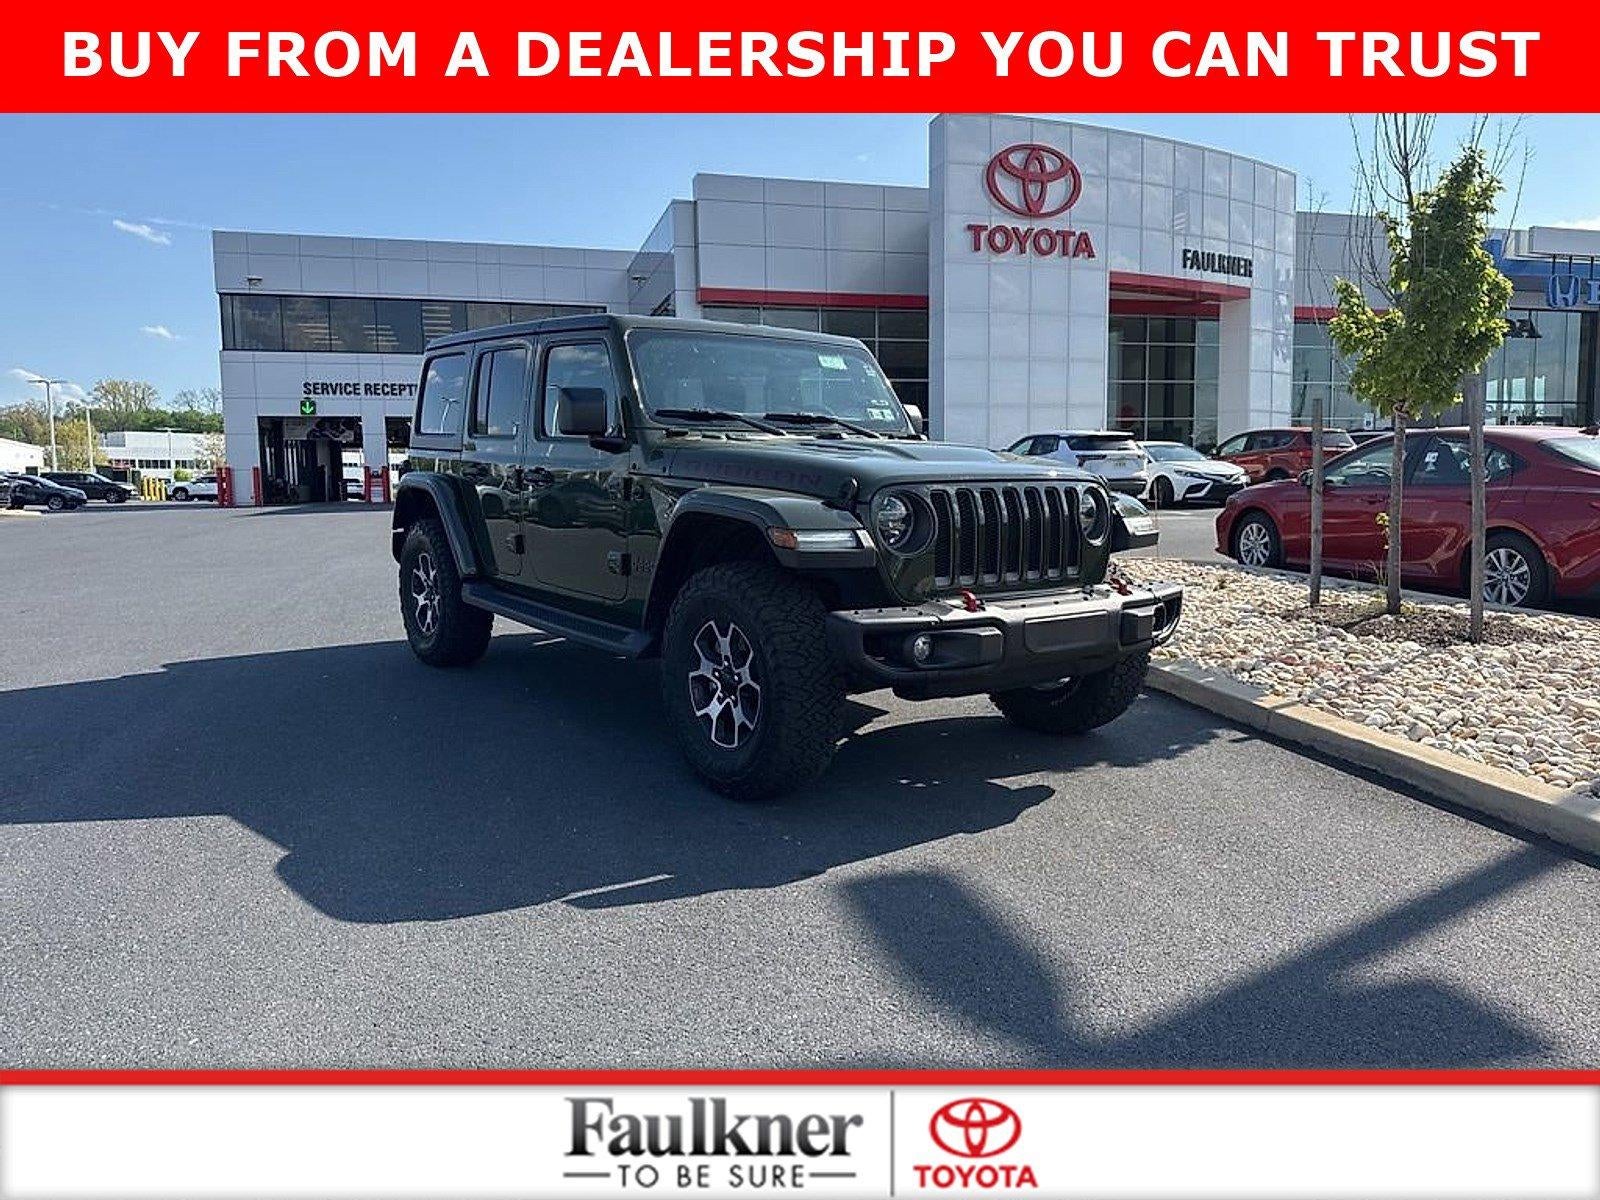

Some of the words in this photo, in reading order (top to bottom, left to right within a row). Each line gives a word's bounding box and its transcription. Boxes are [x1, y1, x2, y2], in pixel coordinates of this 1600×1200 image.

[967, 223, 1096, 259] TOYOTA
[1182, 248, 1253, 278] FAULKNER
[302, 381, 361, 396] SERVICE
